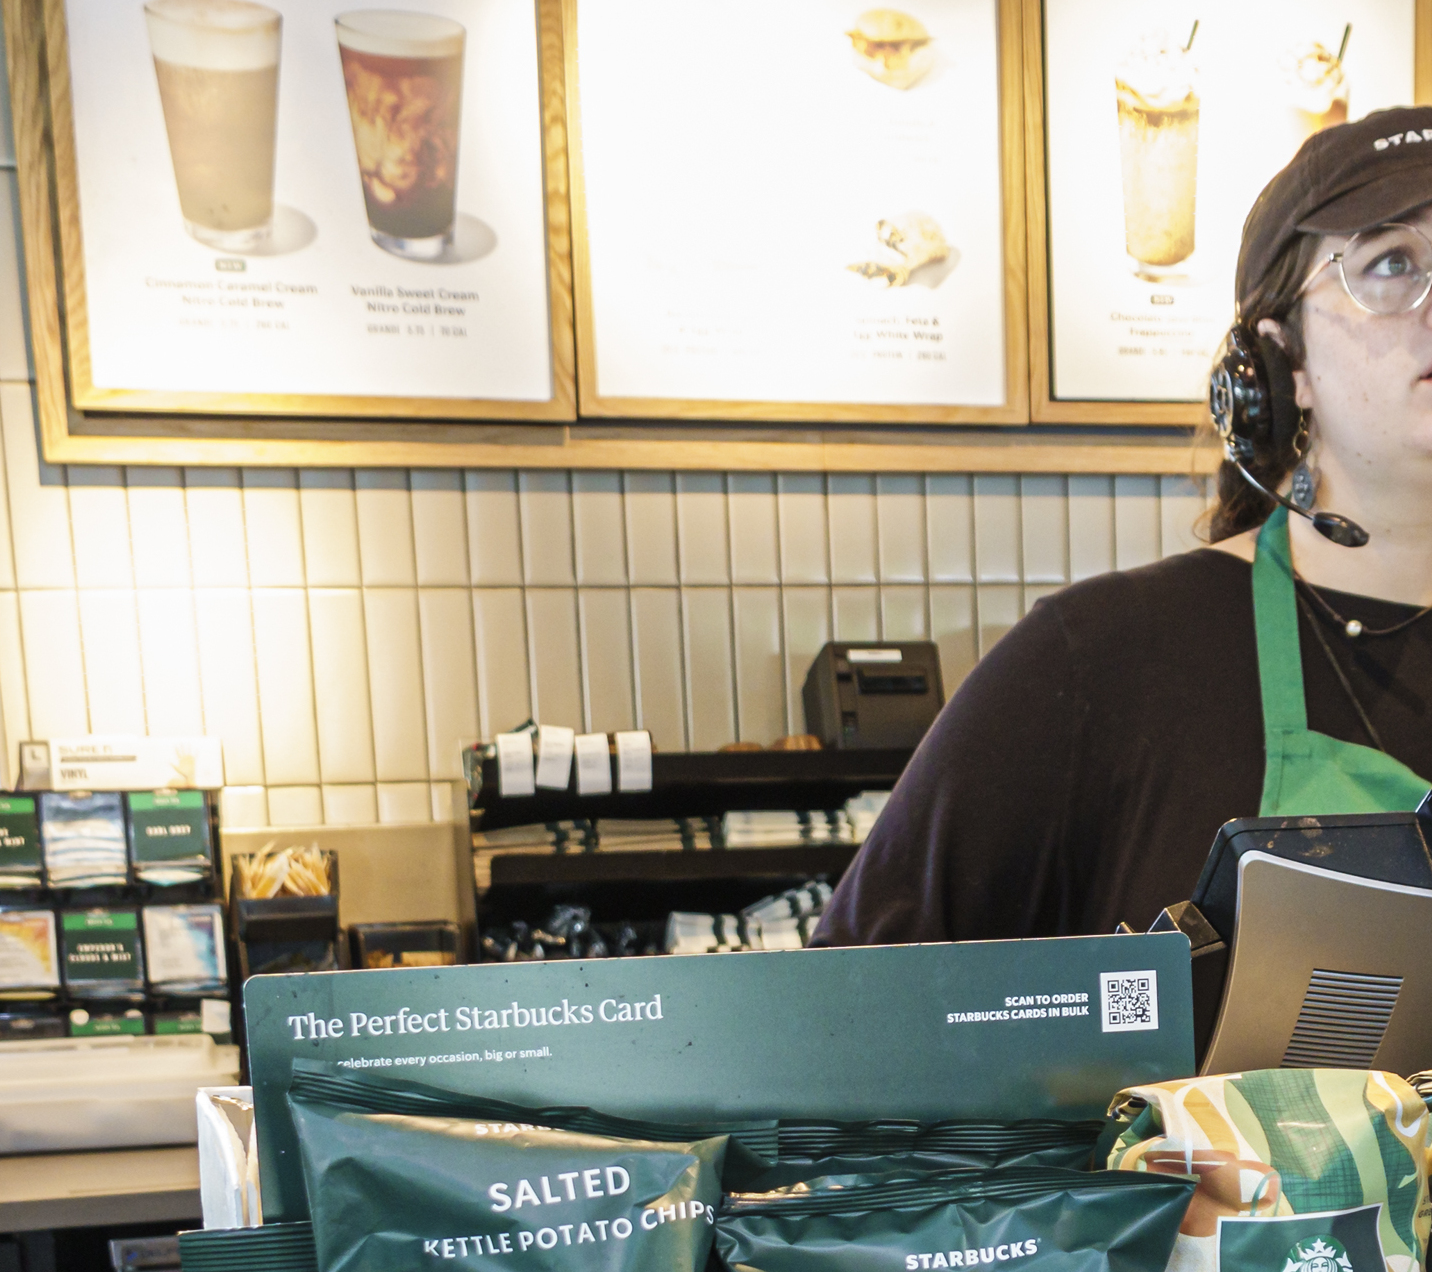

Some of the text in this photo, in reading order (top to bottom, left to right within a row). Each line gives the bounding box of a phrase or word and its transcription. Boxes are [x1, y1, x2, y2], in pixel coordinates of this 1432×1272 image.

[145, 277, 318, 295] Cinnamon Caramel Cream
[350, 284, 480, 303] Vanilla Sweet Cream
[181, 294, 285, 310] Nitro Cold Brew
[365, 301, 466, 317] Nitro Cold Brew
[60, 768, 88, 780] VINYL
[1005, 993, 1089, 1007] SCAN TO ORDER
[288, 994, 664, 1040] The Perfect Starbucks Card
[947, 1005, 1089, 1023] STARBUCKS CARDS IN BULK
[394, 1054, 426, 1067] every
[429, 1051, 482, 1064] occasion,
[484, 1049, 503, 1062] big
[520, 1046, 552, 1058] small.
[488, 1166, 631, 1212] SALTED
[424, 1200, 715, 1260] KETTLE POTATO CHIPS
